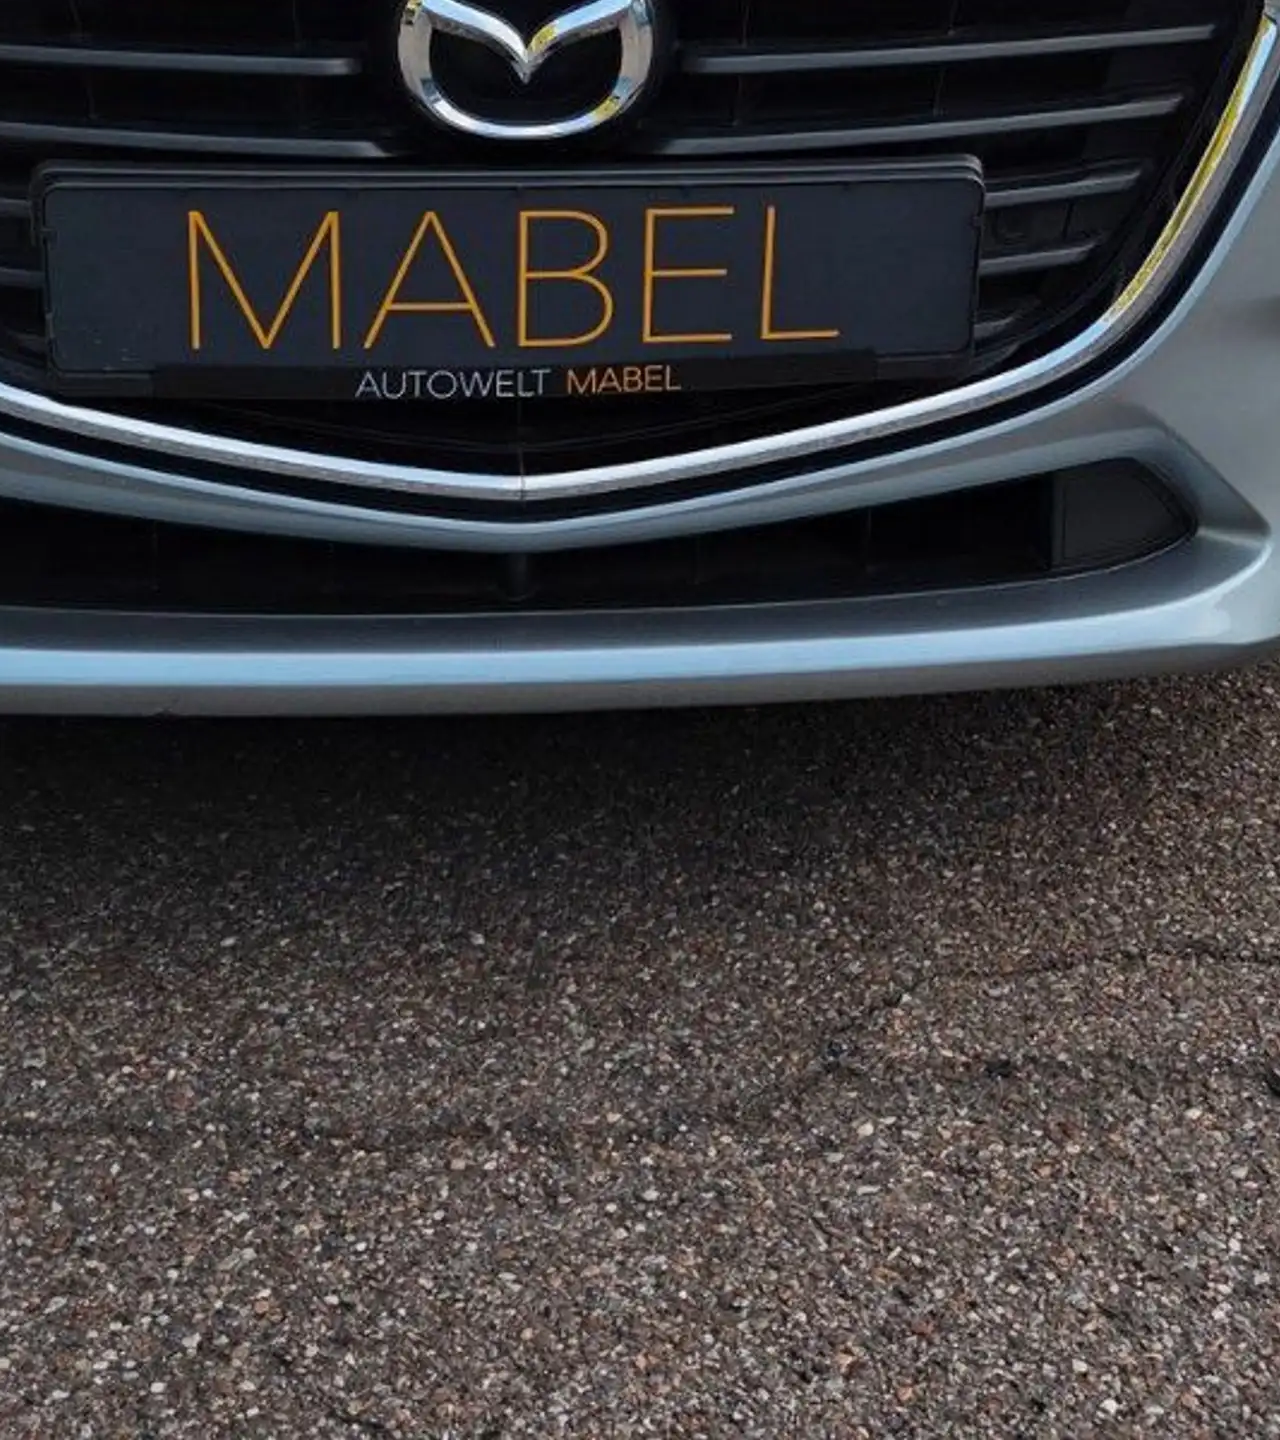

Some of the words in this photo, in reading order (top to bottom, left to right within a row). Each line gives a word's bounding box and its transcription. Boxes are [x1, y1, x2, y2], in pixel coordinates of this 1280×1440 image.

[188, 205, 840, 350] MABEL
[355, 369, 551, 400] AUTOWELT
[567, 365, 682, 394] MABEL
